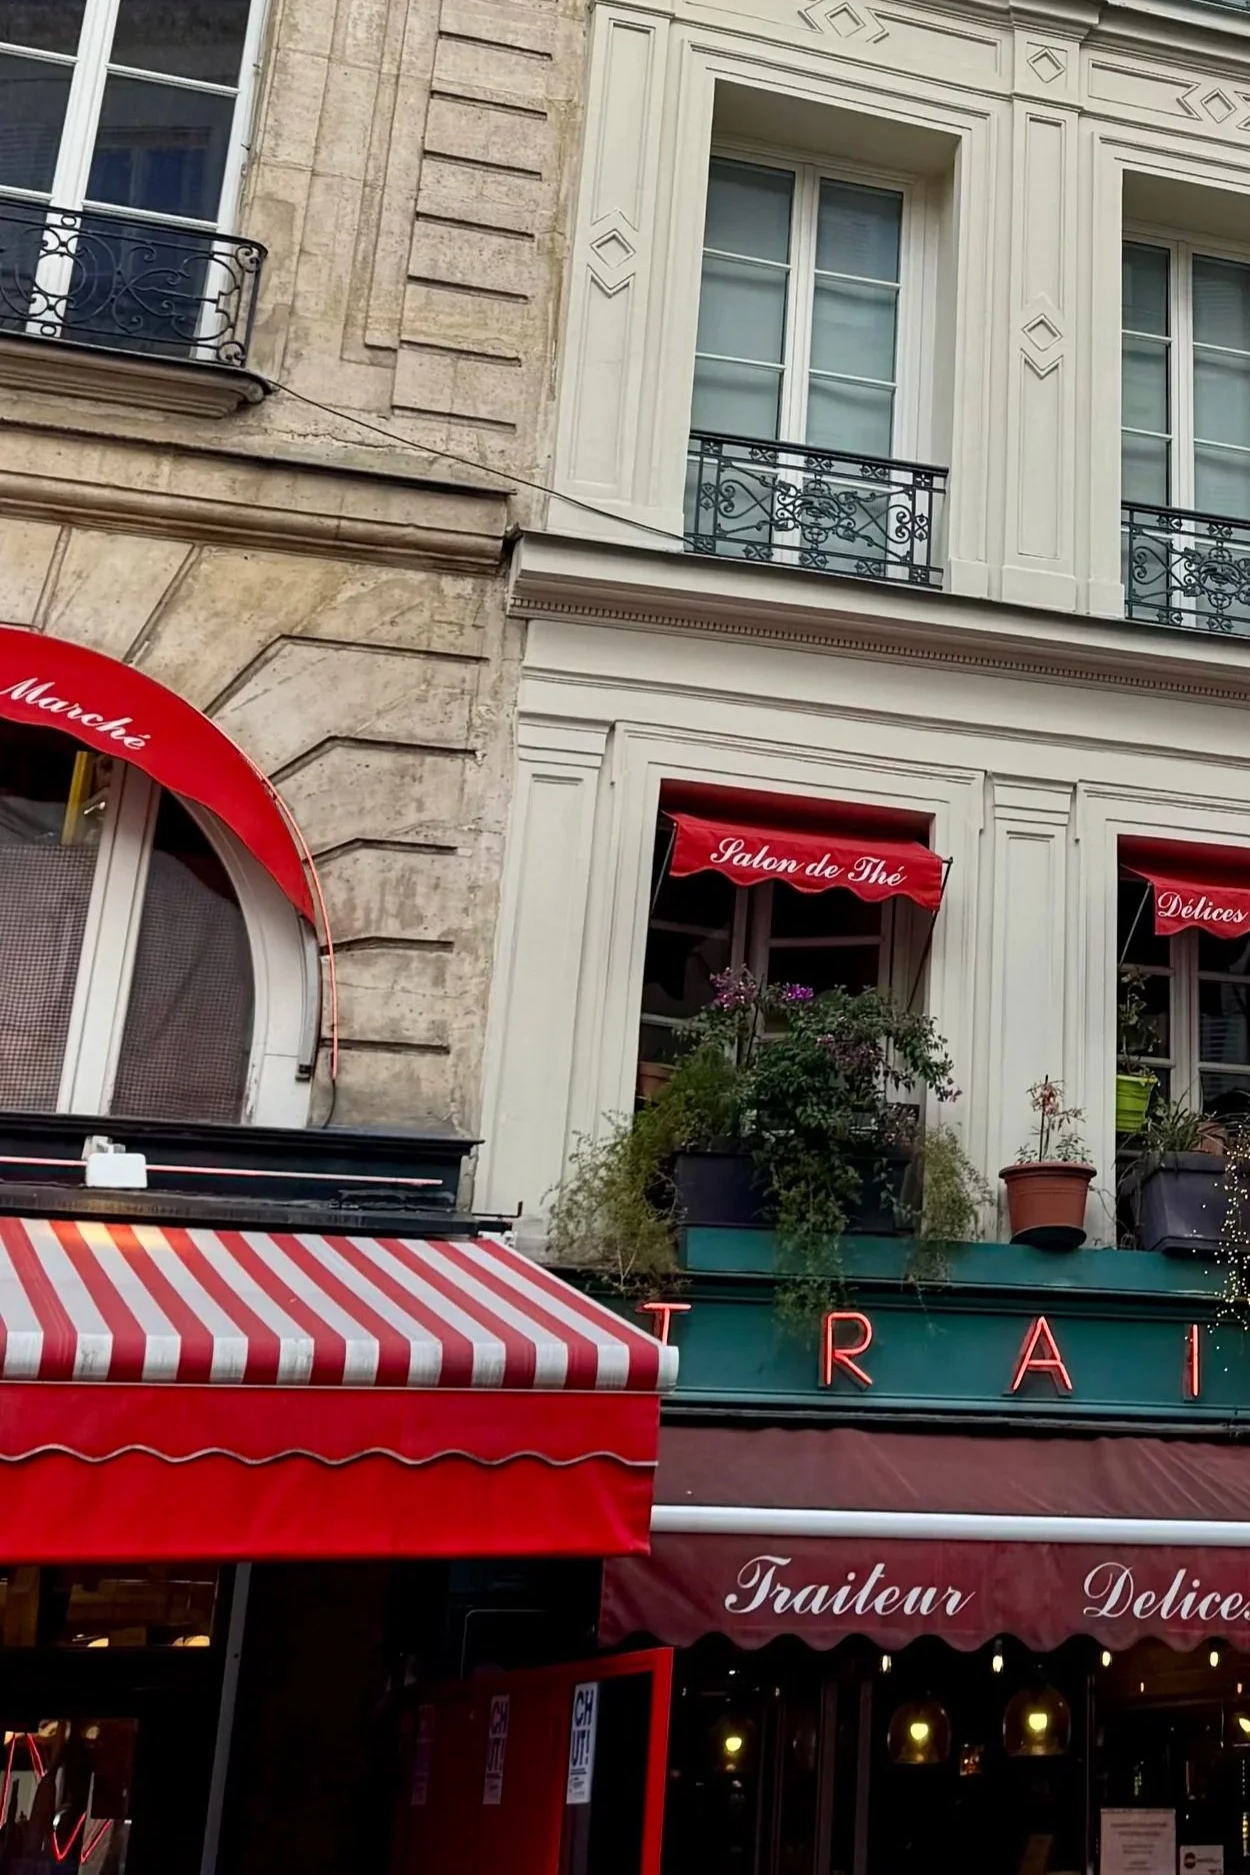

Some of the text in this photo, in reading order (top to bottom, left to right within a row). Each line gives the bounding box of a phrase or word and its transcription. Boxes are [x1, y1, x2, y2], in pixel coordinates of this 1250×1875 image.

[0, 677, 151, 750] Marché
[709, 837, 908, 887] Salon de Thé
[1157, 891, 1249, 924] Délices
[724, 1554, 976, 1616] Traiteur
[575, 1690, 594, 1727] CH
[572, 1729, 591, 1767] UT!
